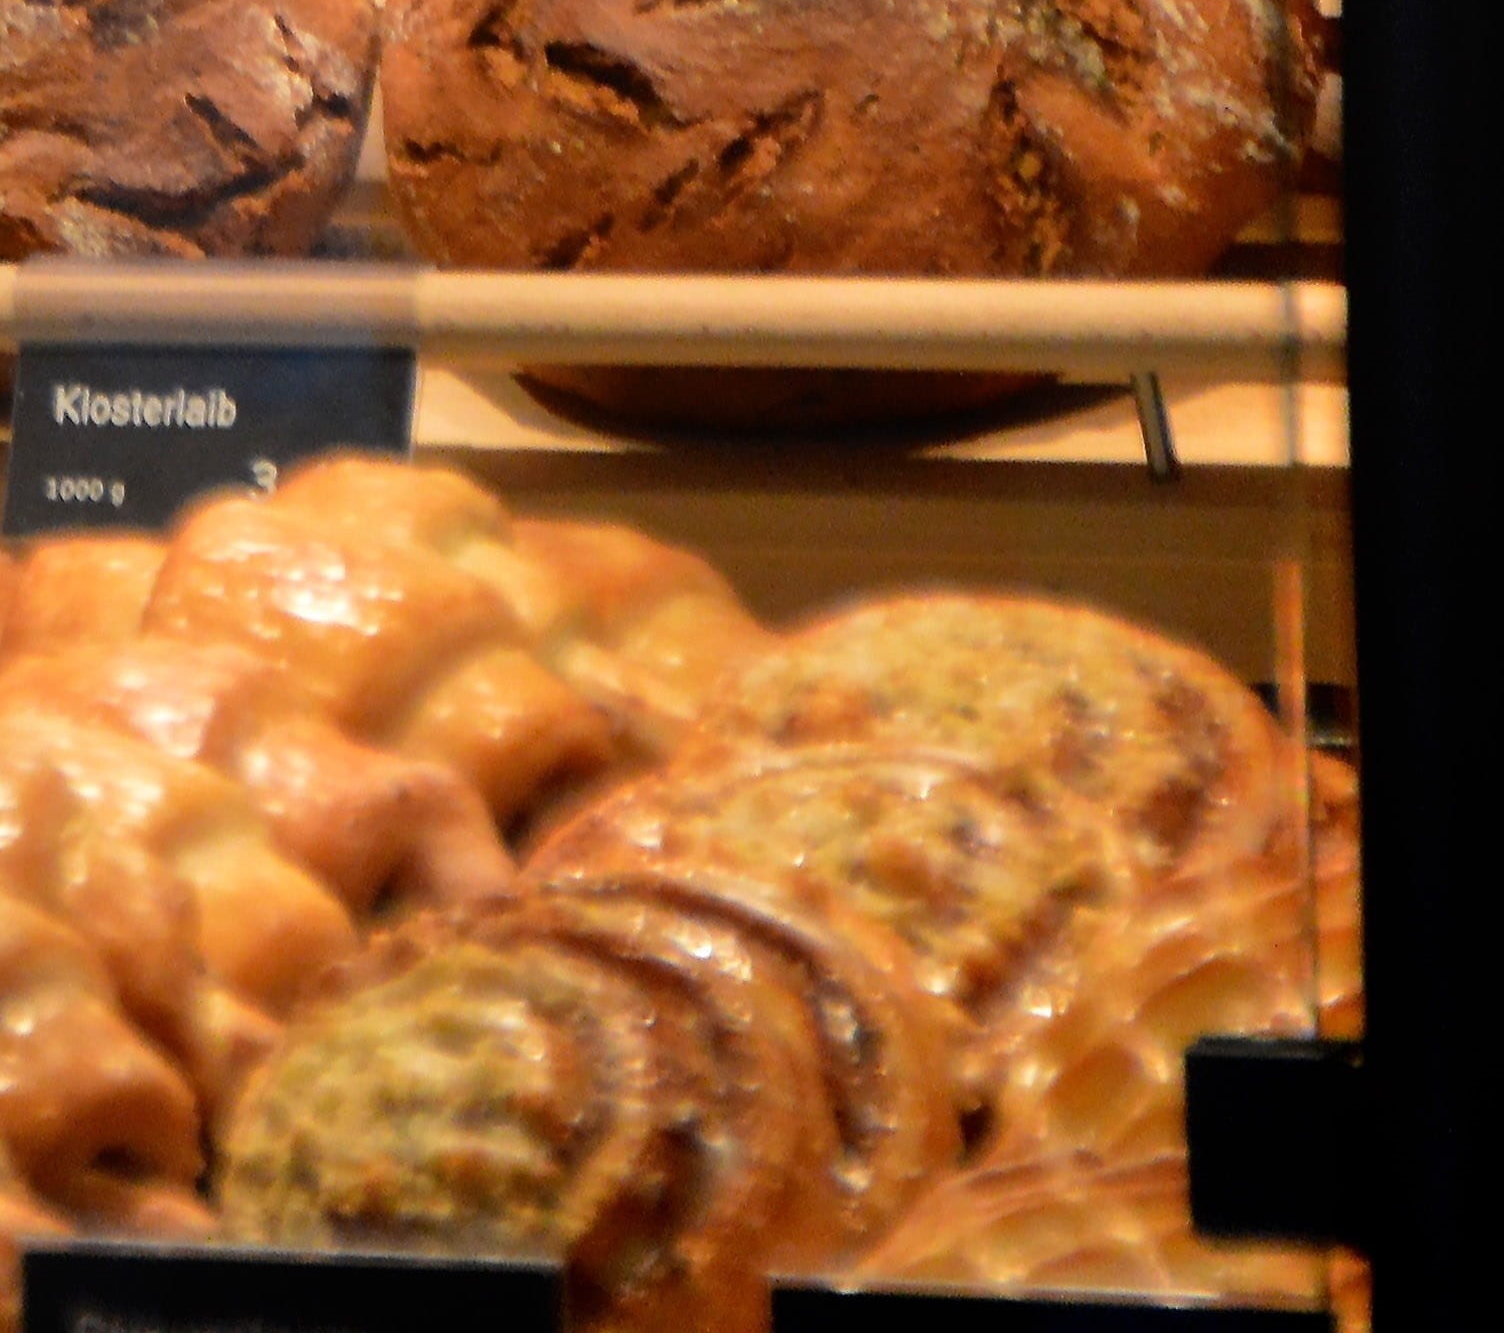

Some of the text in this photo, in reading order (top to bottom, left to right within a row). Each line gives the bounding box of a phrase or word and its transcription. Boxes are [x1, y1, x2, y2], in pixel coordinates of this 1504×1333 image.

[53, 383, 238, 429] Klosterlaib
[45, 476, 105, 504] 1000
[110, 478, 126, 508] g
